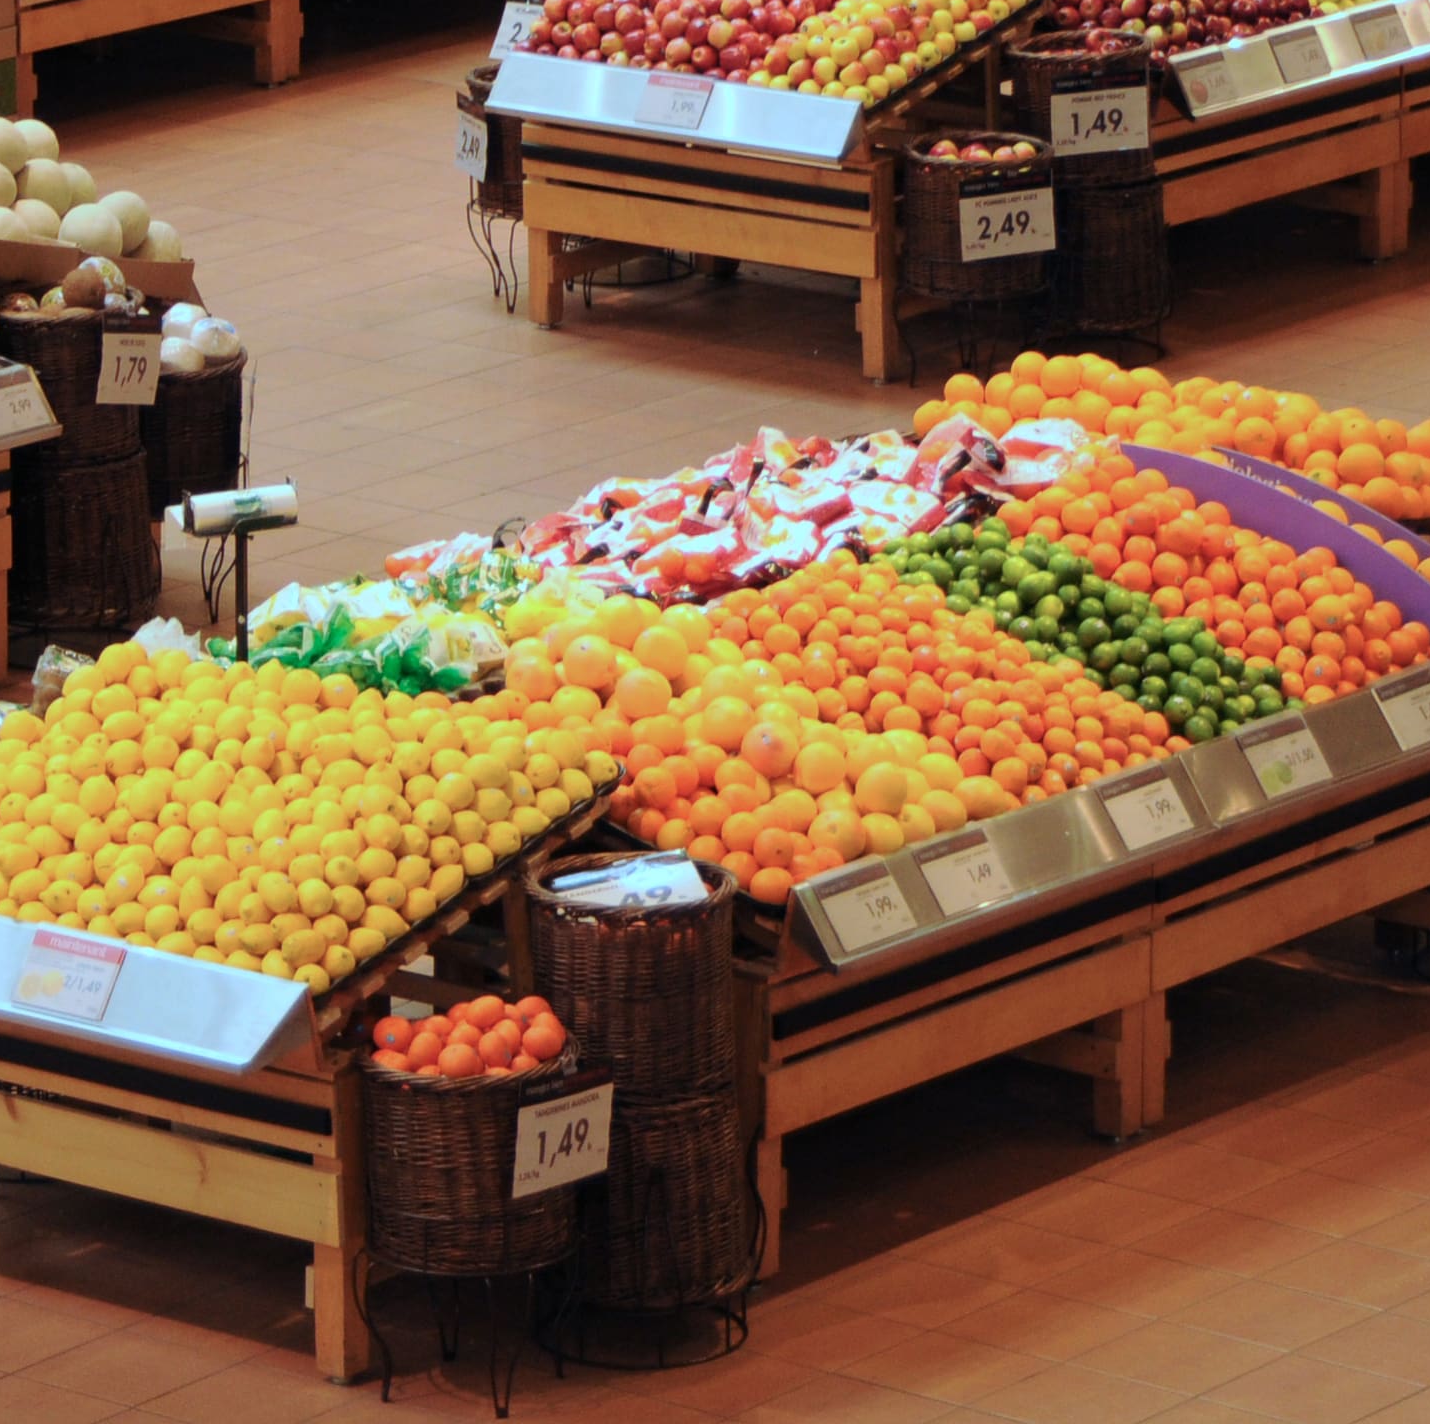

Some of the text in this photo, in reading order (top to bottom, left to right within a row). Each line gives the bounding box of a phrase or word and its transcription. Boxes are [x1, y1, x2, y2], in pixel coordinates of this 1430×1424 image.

[1071, 108, 1124, 140] 1,49
[461, 130, 481, 160] 2,49
[977, 210, 1031, 244] 2,49
[114, 355, 147, 387] 1,79
[9, 399, 32, 415] 2,99
[1145, 798, 1171, 820] 1,99
[967, 862, 992, 883] 1,49
[865, 895, 892, 918] 1,99
[48, 936, 107, 956] maintenant
[65, 975, 101, 993] 2/1,49
[537, 1117, 589, 1169] 1,49
